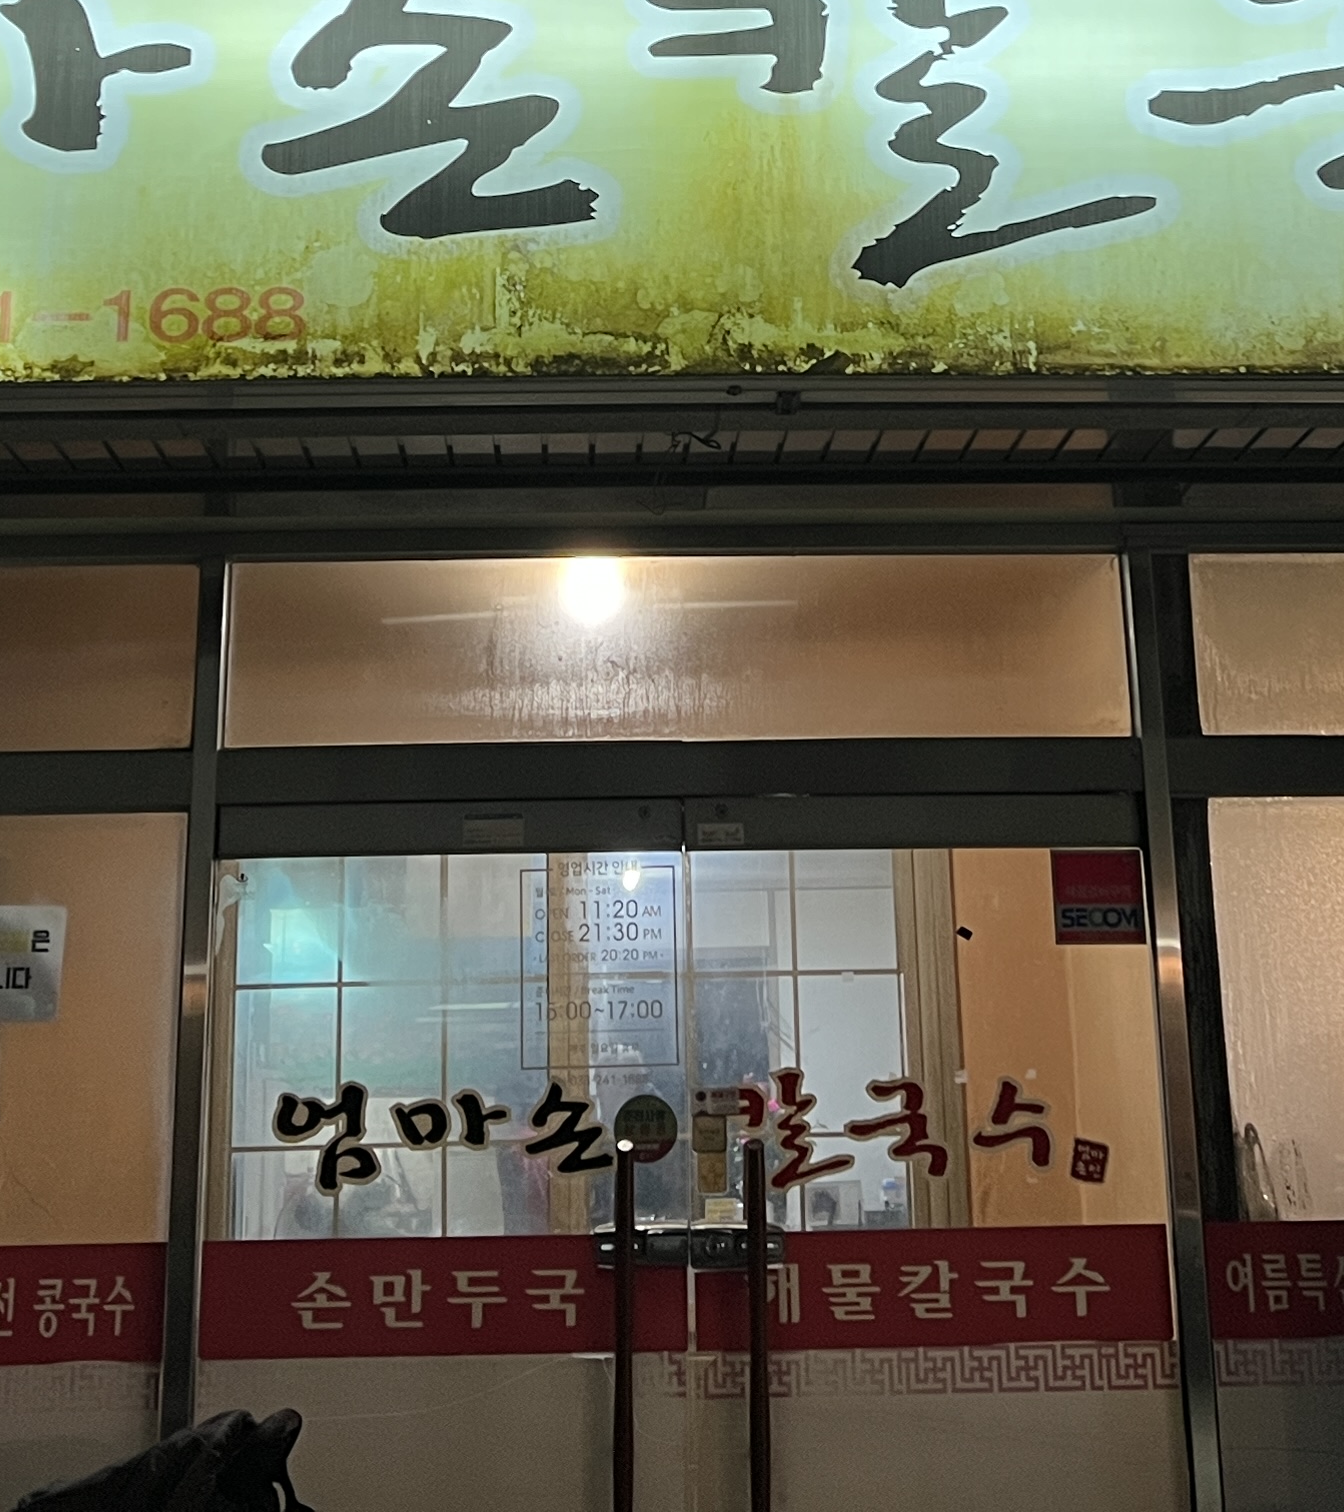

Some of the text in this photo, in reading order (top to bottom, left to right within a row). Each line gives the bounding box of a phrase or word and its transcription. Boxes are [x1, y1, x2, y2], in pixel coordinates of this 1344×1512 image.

[558, 861, 608, 877] 영업시간
[565, 887, 587, 896] Mon
[595, 886, 611, 896] Sat
[534, 900, 662, 920] OEN 11:20 AM
[1062, 907, 1139, 928] SECOM
[534, 921, 662, 943] COSE 21:30 PM
[601, 948, 639, 962] 20:20
[642, 951, 659, 961] PM
[612, 984, 635, 994] Time
[536, 999, 663, 1021] 15:00~17:00
[33, 1276, 135, 1338] 콩국수
[290, 1268, 586, 1330] 손만두국
